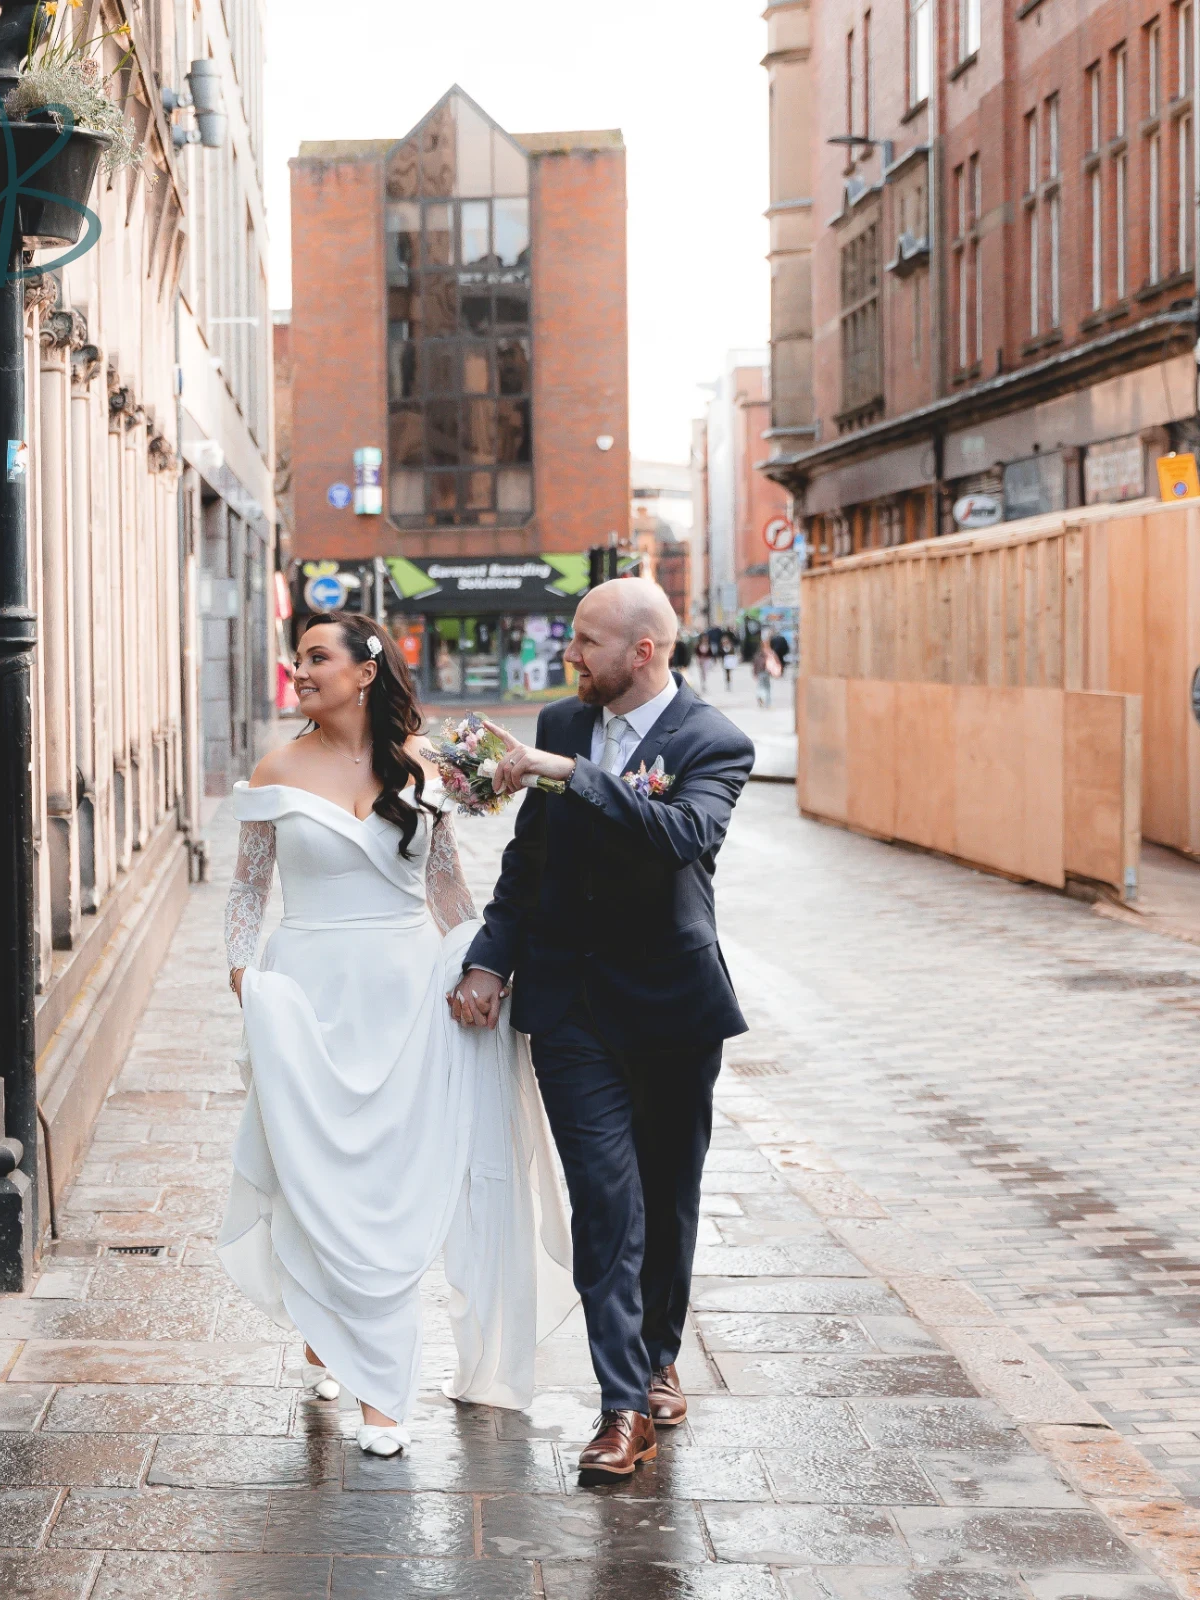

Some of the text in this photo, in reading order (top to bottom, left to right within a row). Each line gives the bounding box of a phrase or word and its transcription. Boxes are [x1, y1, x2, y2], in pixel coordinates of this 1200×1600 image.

[428, 563, 552, 579] Garment Branding
[457, 577, 522, 590] Solutions
